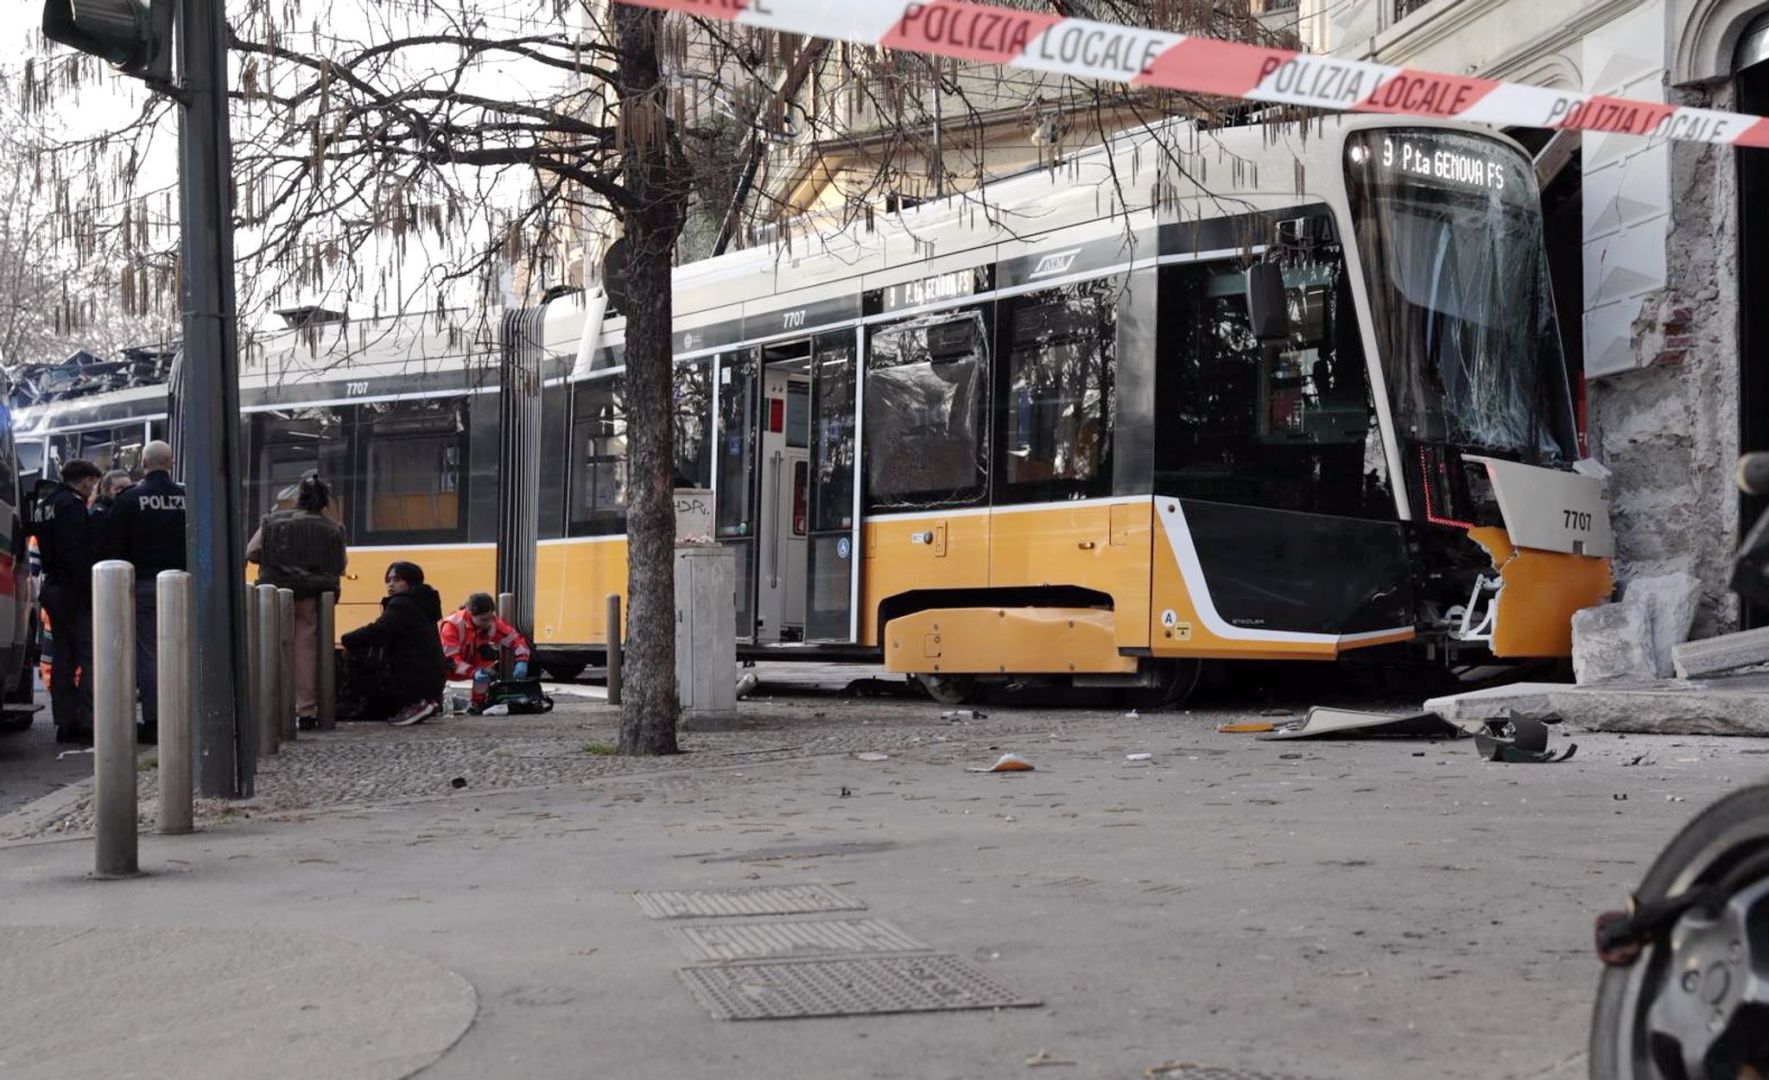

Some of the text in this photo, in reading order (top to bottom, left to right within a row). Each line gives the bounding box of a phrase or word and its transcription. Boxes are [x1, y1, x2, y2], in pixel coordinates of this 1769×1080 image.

[900, 3, 1164, 75] POLIZIA LOCALE
[1256, 57, 1473, 116] POLIZIA LOCALE
[1545, 98, 1639, 133] POLIZIA
[1402, 142, 1431, 175] P.ta
[1434, 151, 1484, 186] GENOVA
[1487, 161, 1504, 190] FS
[783, 310, 806, 329] 7707
[346, 381, 369, 396] 7707
[139, 495, 185, 511] POLIZI
[1563, 510, 1592, 532] 7707
[1164, 613, 1173, 624] A
